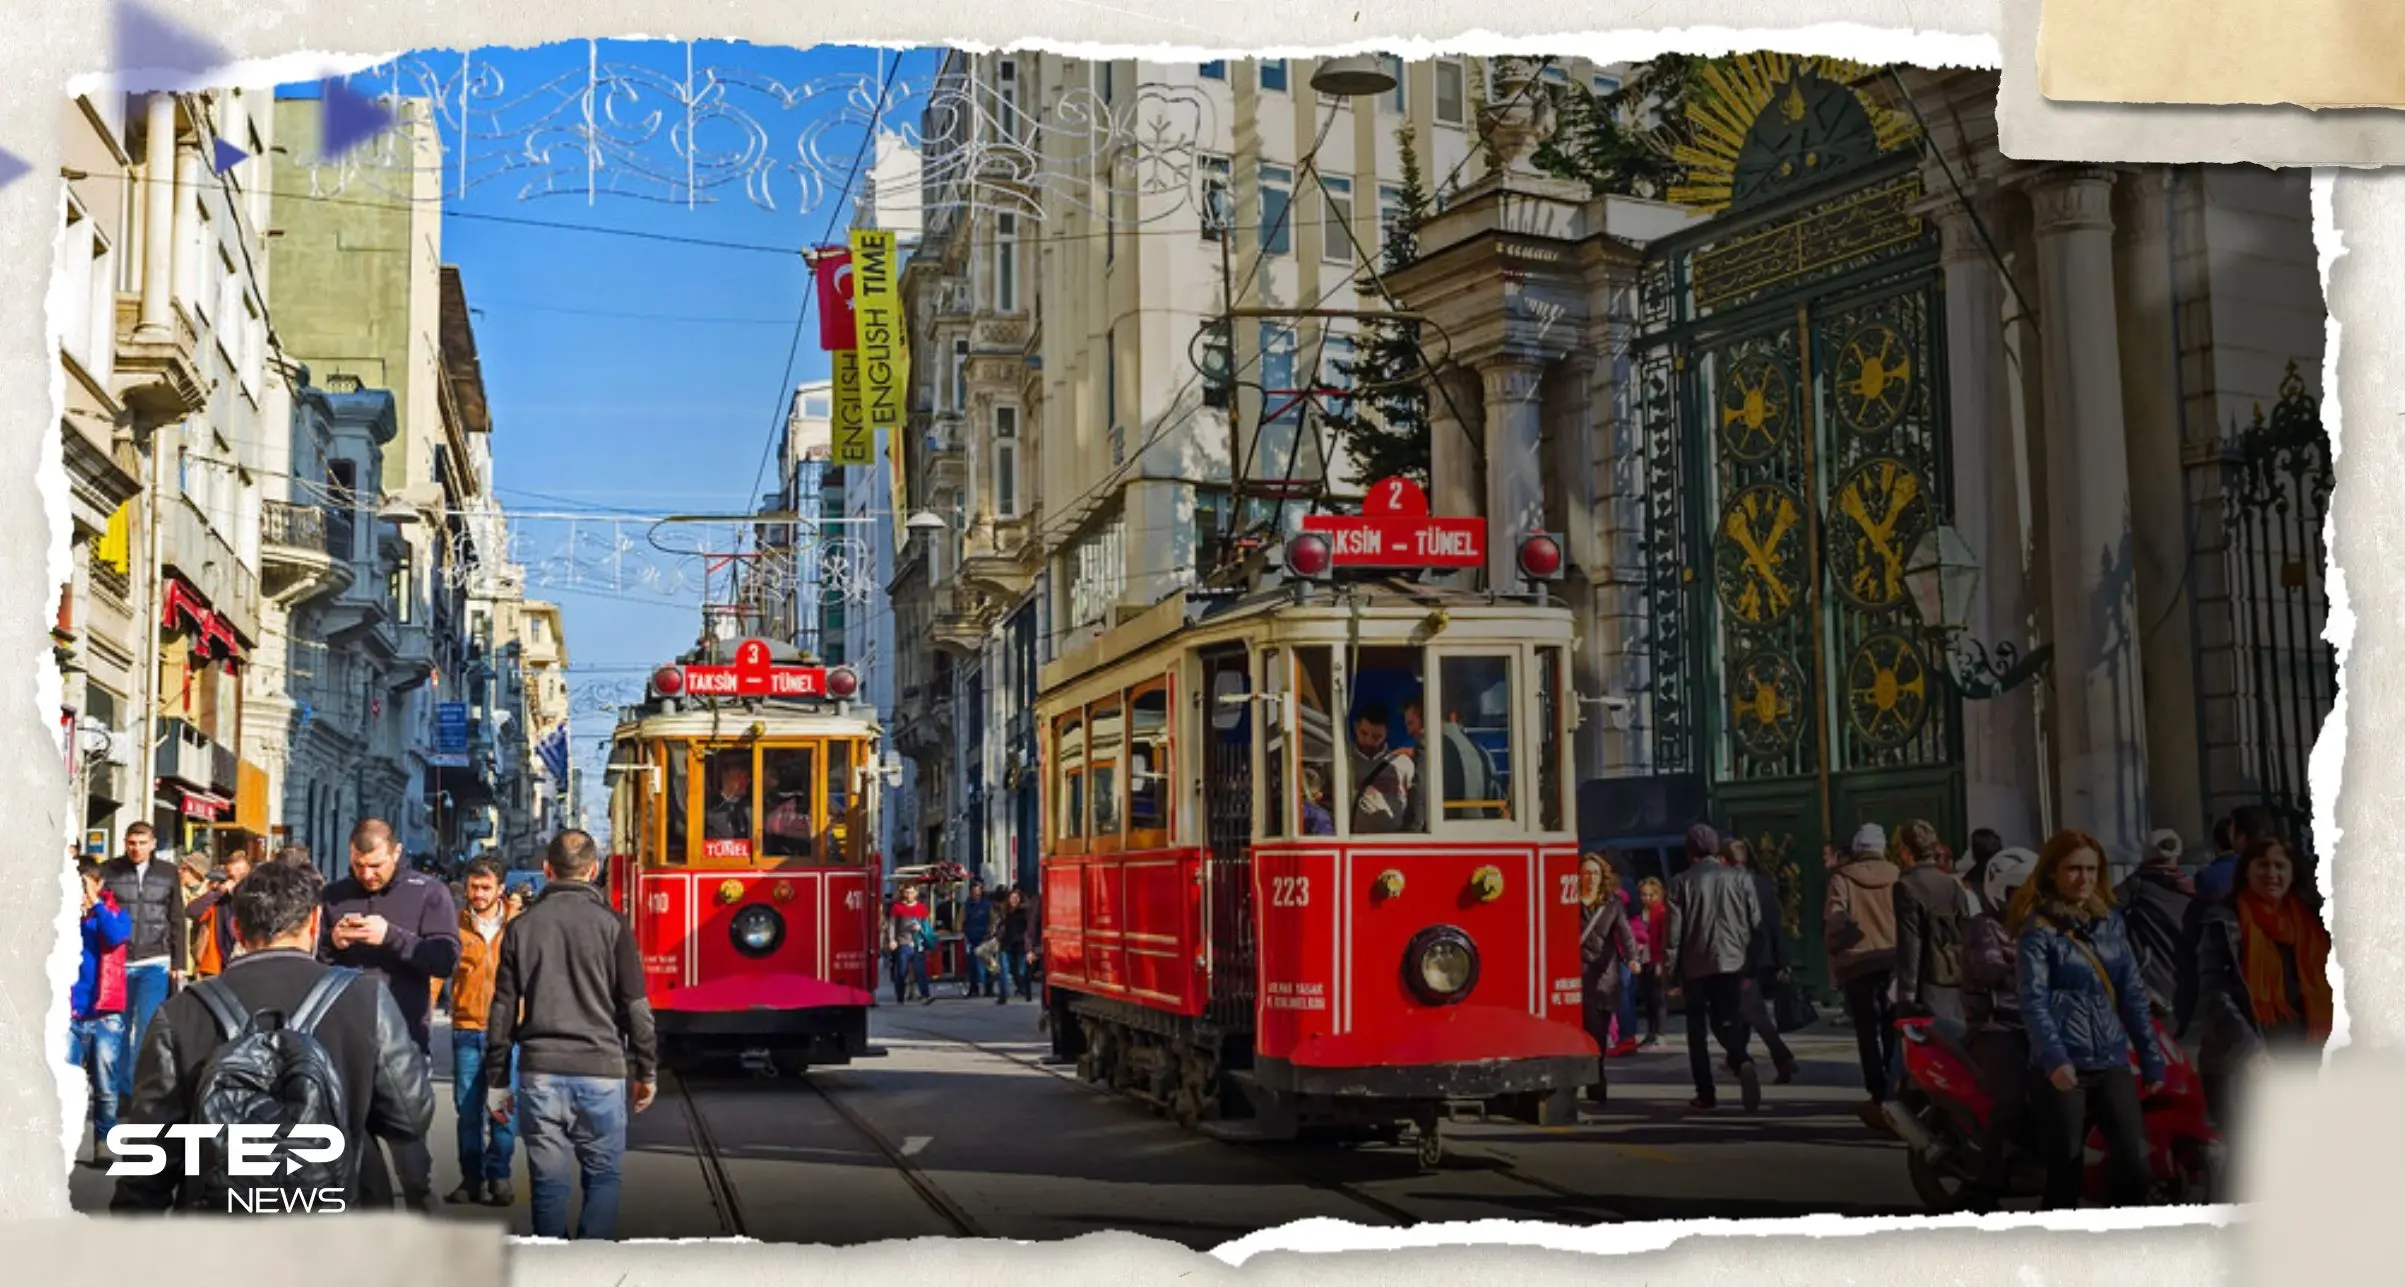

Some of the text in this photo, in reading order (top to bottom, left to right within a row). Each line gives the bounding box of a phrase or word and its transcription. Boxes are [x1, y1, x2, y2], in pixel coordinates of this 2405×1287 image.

[861, 235, 897, 424] ENGLISH TIME
[841, 353, 866, 461] ENGLISH
[1388, 480, 1404, 510] 2
[1330, 525, 1382, 555] KSİM
[1414, 526, 1479, 557] TÜNEL
[747, 643, 760, 664] 3
[770, 671, 817, 693] TÜNEL
[1272, 876, 1310, 907] 223
